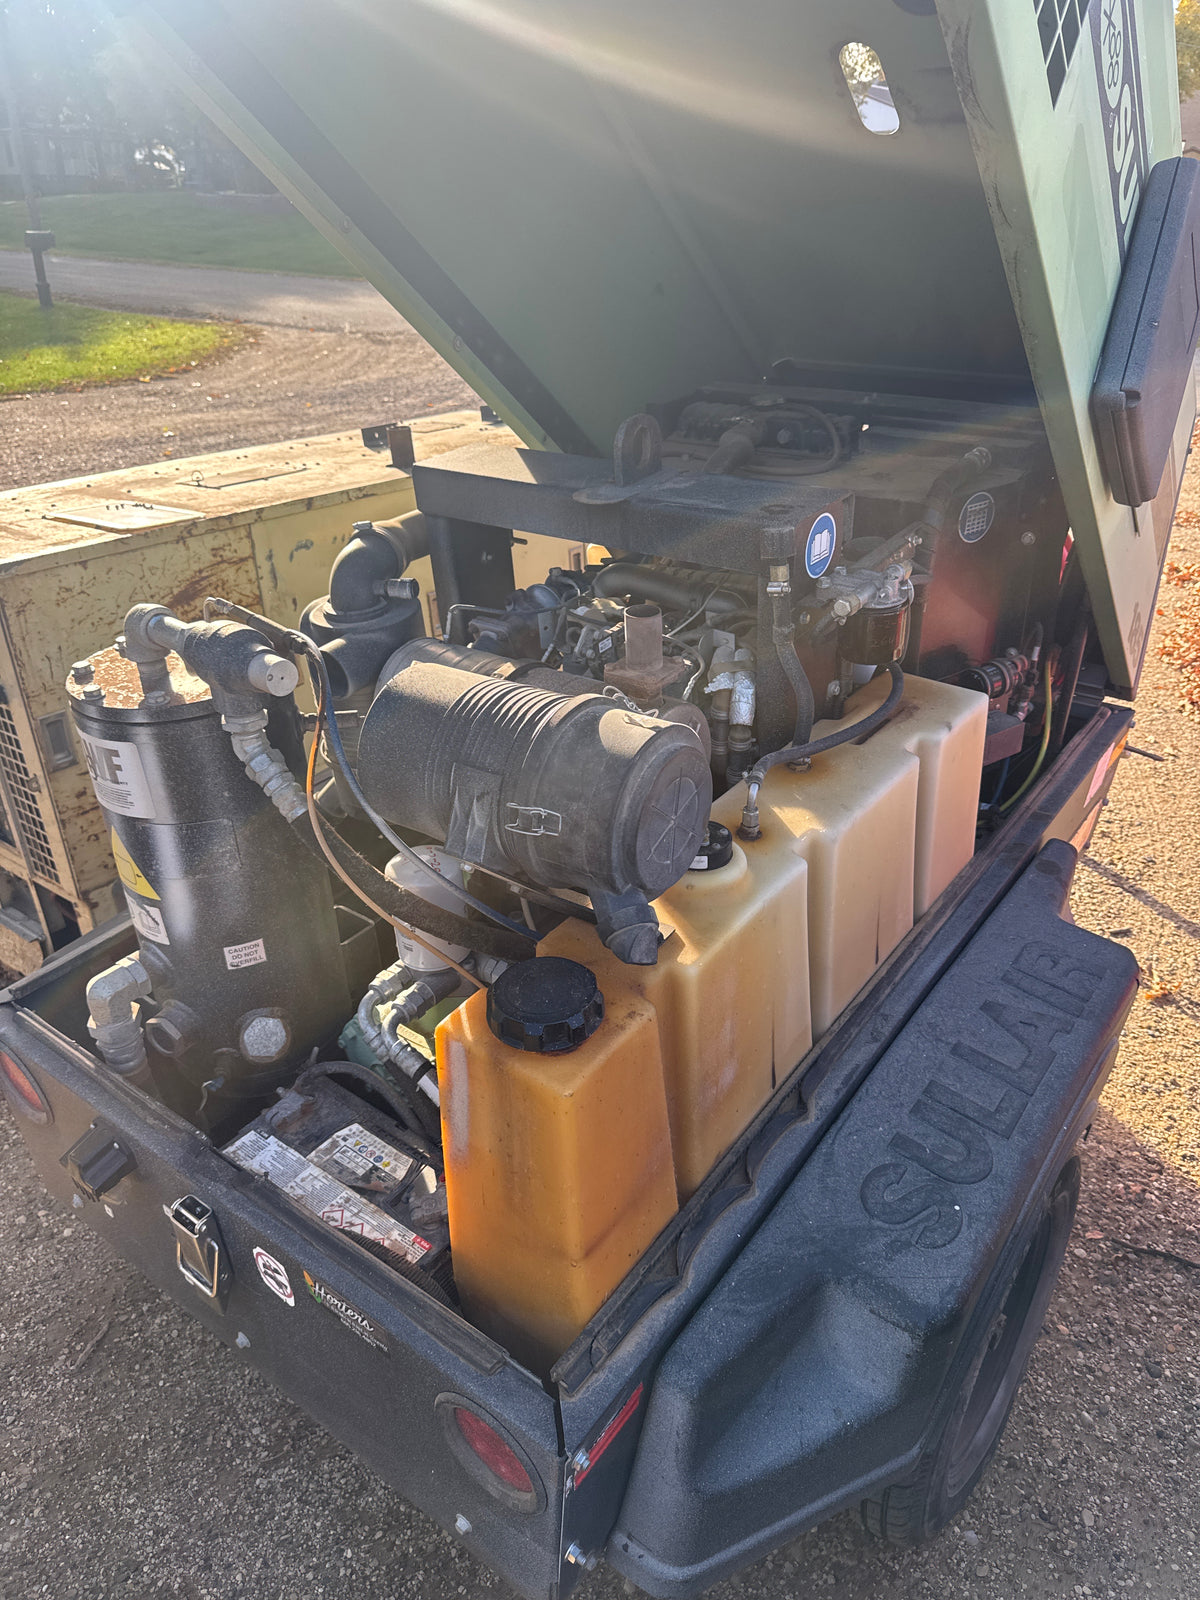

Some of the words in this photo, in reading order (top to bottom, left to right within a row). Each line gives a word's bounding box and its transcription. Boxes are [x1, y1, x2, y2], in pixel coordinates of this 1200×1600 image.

[228, 943, 260, 954] CAUTION
[230, 955, 264, 966] OVERFILL
[861, 940, 1104, 1249] SULLAIR
